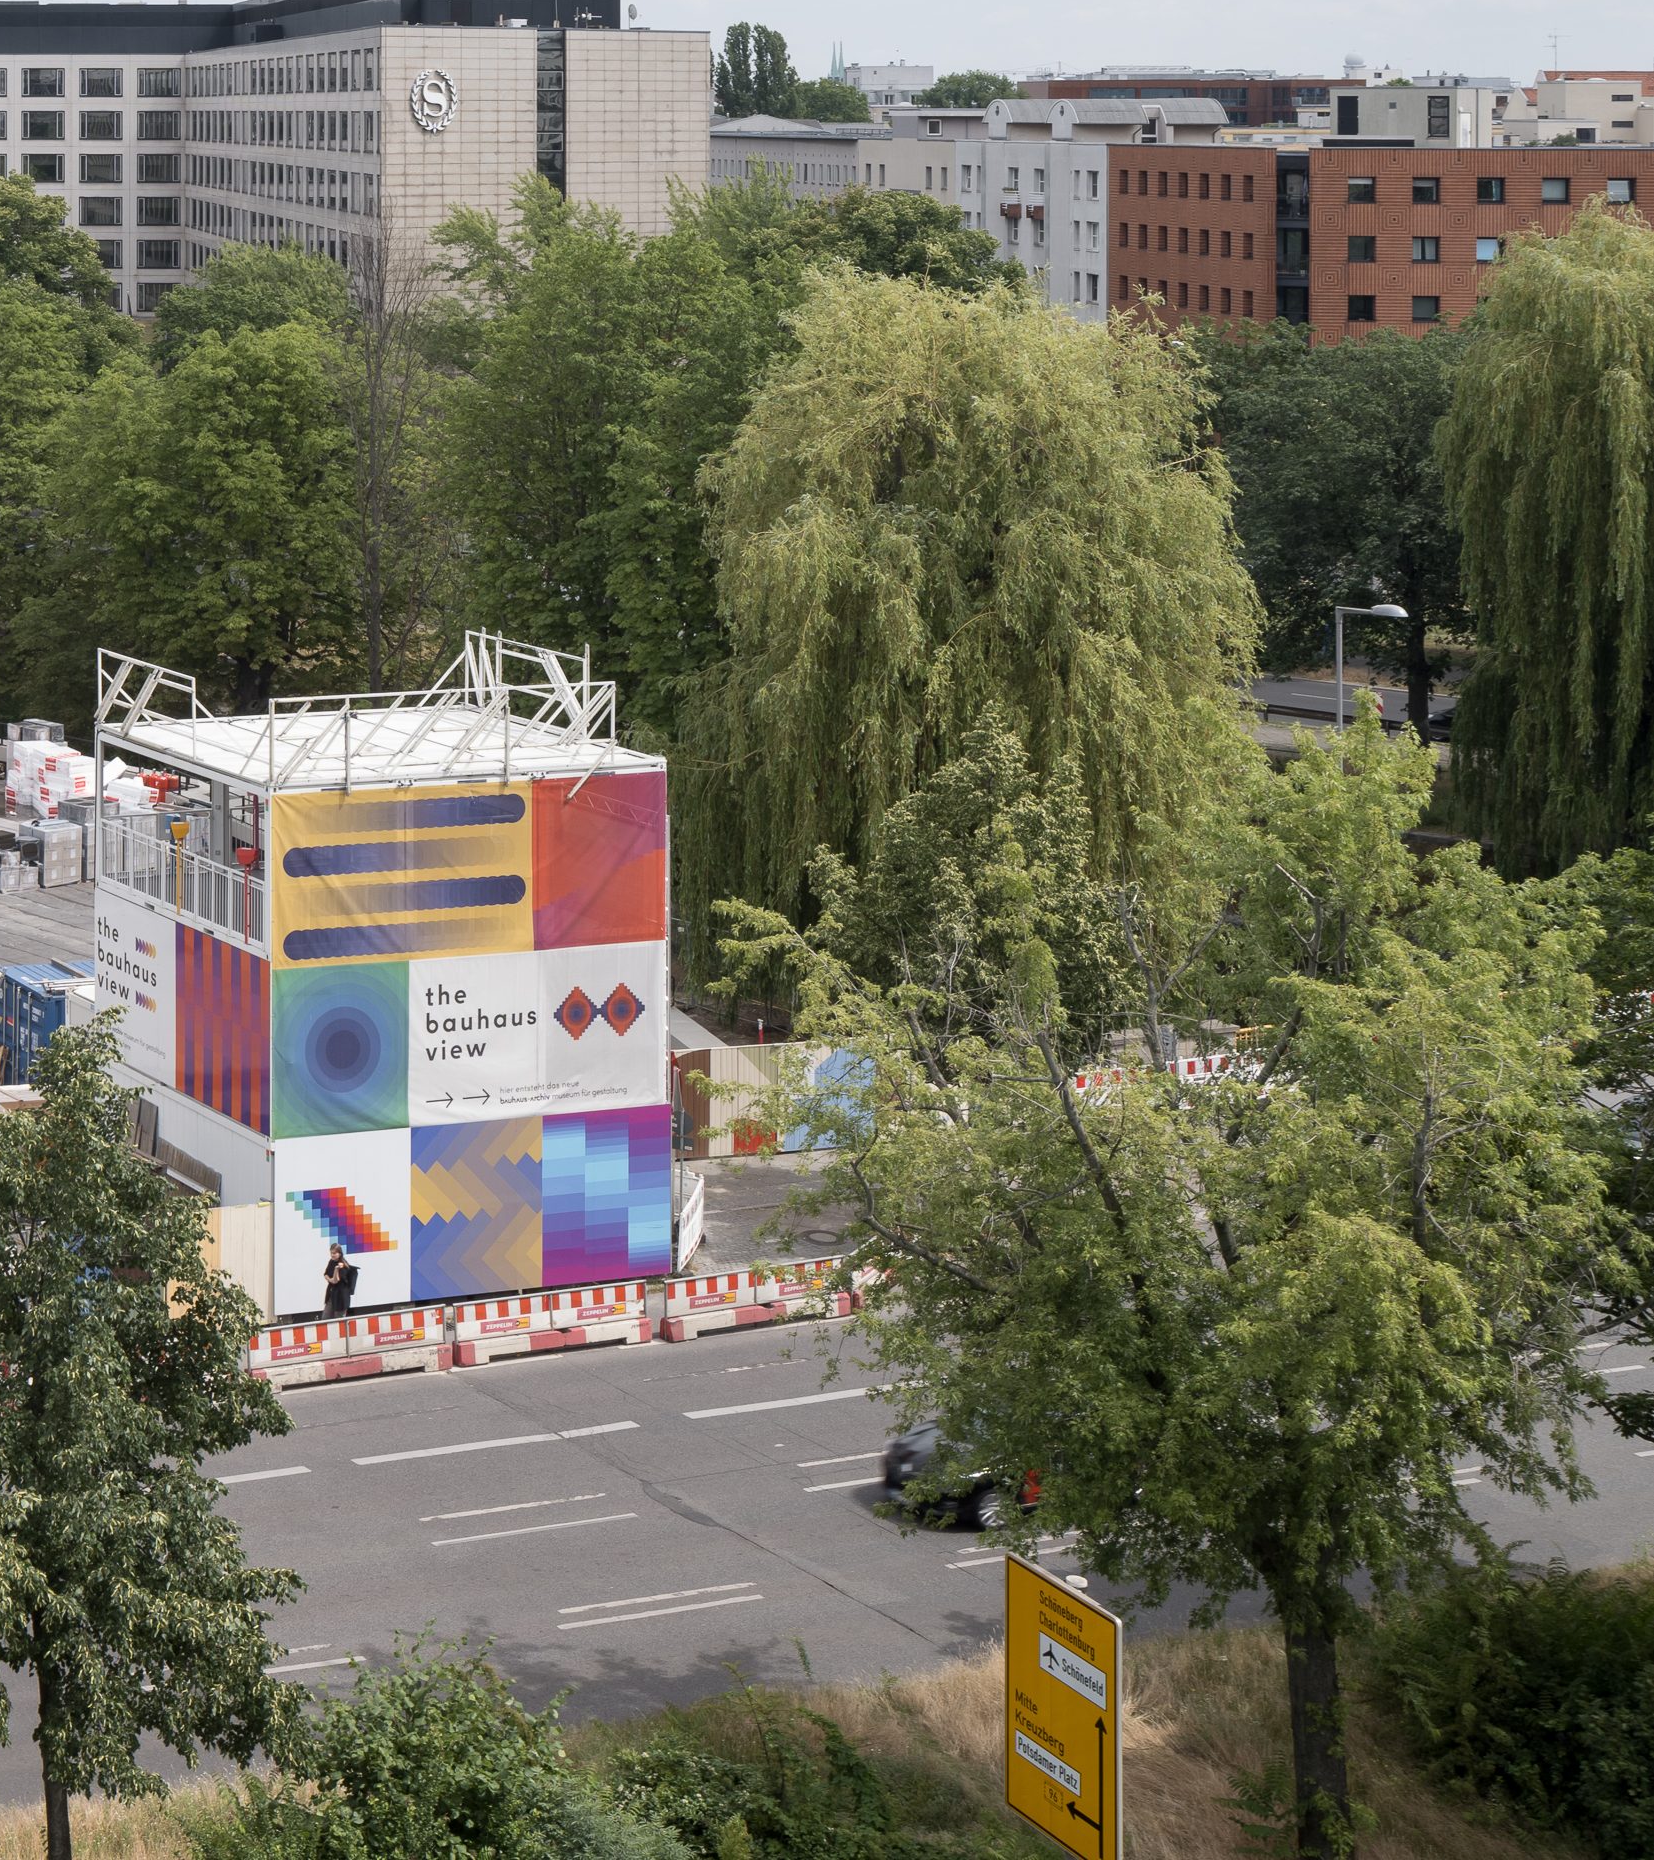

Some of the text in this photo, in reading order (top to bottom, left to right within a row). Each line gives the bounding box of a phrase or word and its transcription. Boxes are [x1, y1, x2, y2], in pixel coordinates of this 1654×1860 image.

[422, 80, 448, 118] S
[98, 916, 119, 943] the
[97, 940, 157, 987] bauhaus
[97, 971, 130, 1001] view
[425, 984, 467, 1007] the
[426, 1008, 537, 1034] bauhaus
[425, 1040, 487, 1062] view
[500, 1081, 580, 1094] hier entsteht das neue
[552, 1091, 580, 1100] museum
[581, 1088, 591, 1097] für
[592, 1086, 628, 1098] gestaltung
[582, 1307, 609, 1317] ZEPPELIN
[694, 1296, 720, 1306] ZEPPELIN
[379, 1333, 407, 1343] ZEPPELIN
[485, 1321, 513, 1331] ZEPPELIN
[276, 1347, 305, 1357] ZEPPELIN
[1039, 1590, 1083, 1632] Schöneberg
[1039, 1610, 1095, 1661] Charlottenburg
[1061, 1658, 1104, 1697] Schönefeld
[1015, 1688, 1038, 1715] Mitte
[1015, 1708, 1065, 1757] Kreuzberg
[1018, 1736, 1079, 1790] Potsdamer Platz
[1048, 1788, 1058, 1803] 96
